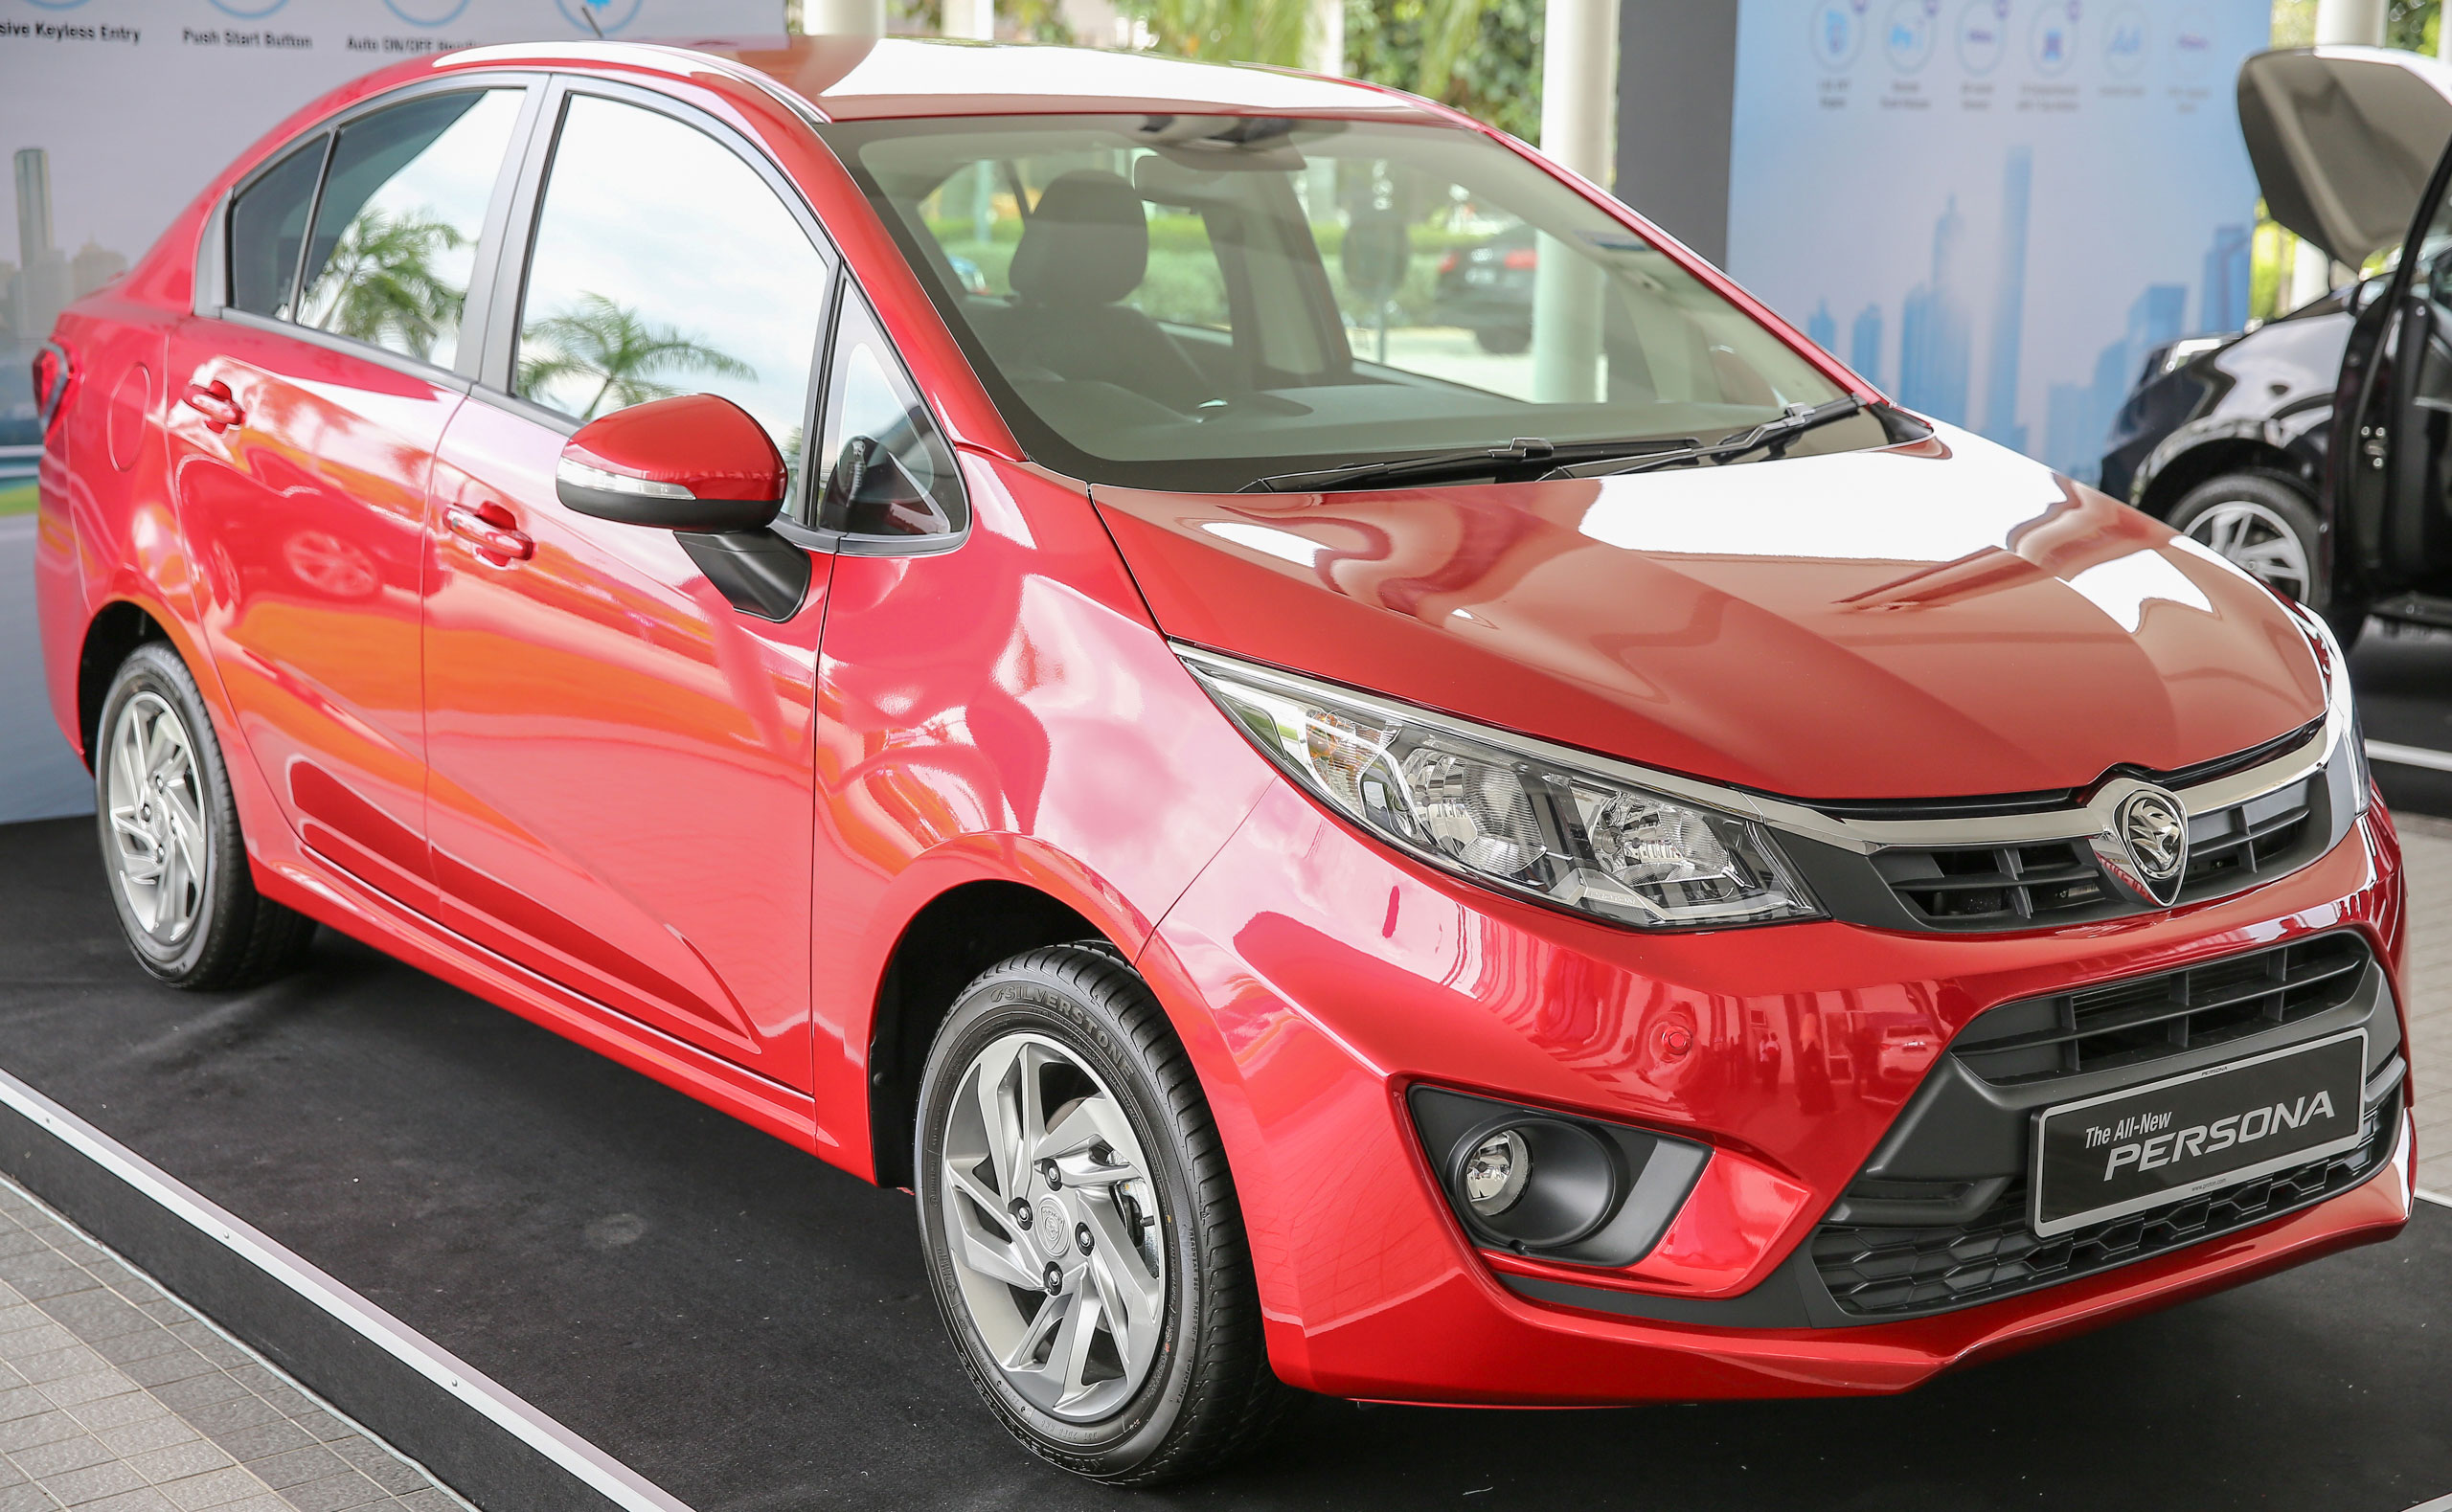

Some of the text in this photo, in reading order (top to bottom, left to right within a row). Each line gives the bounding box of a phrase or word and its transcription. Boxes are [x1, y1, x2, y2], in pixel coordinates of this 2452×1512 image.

[34, 21, 96, 42] Keyless
[101, 24, 142, 44] Entry
[182, 29, 314, 49] Push Start Button
[346, 35, 378, 52] Auto
[1005, 984, 1136, 1082] SILVERSTONE
[2085, 1111, 2172, 1149] The All-New
[2103, 1090, 2336, 1182] PERSONA
